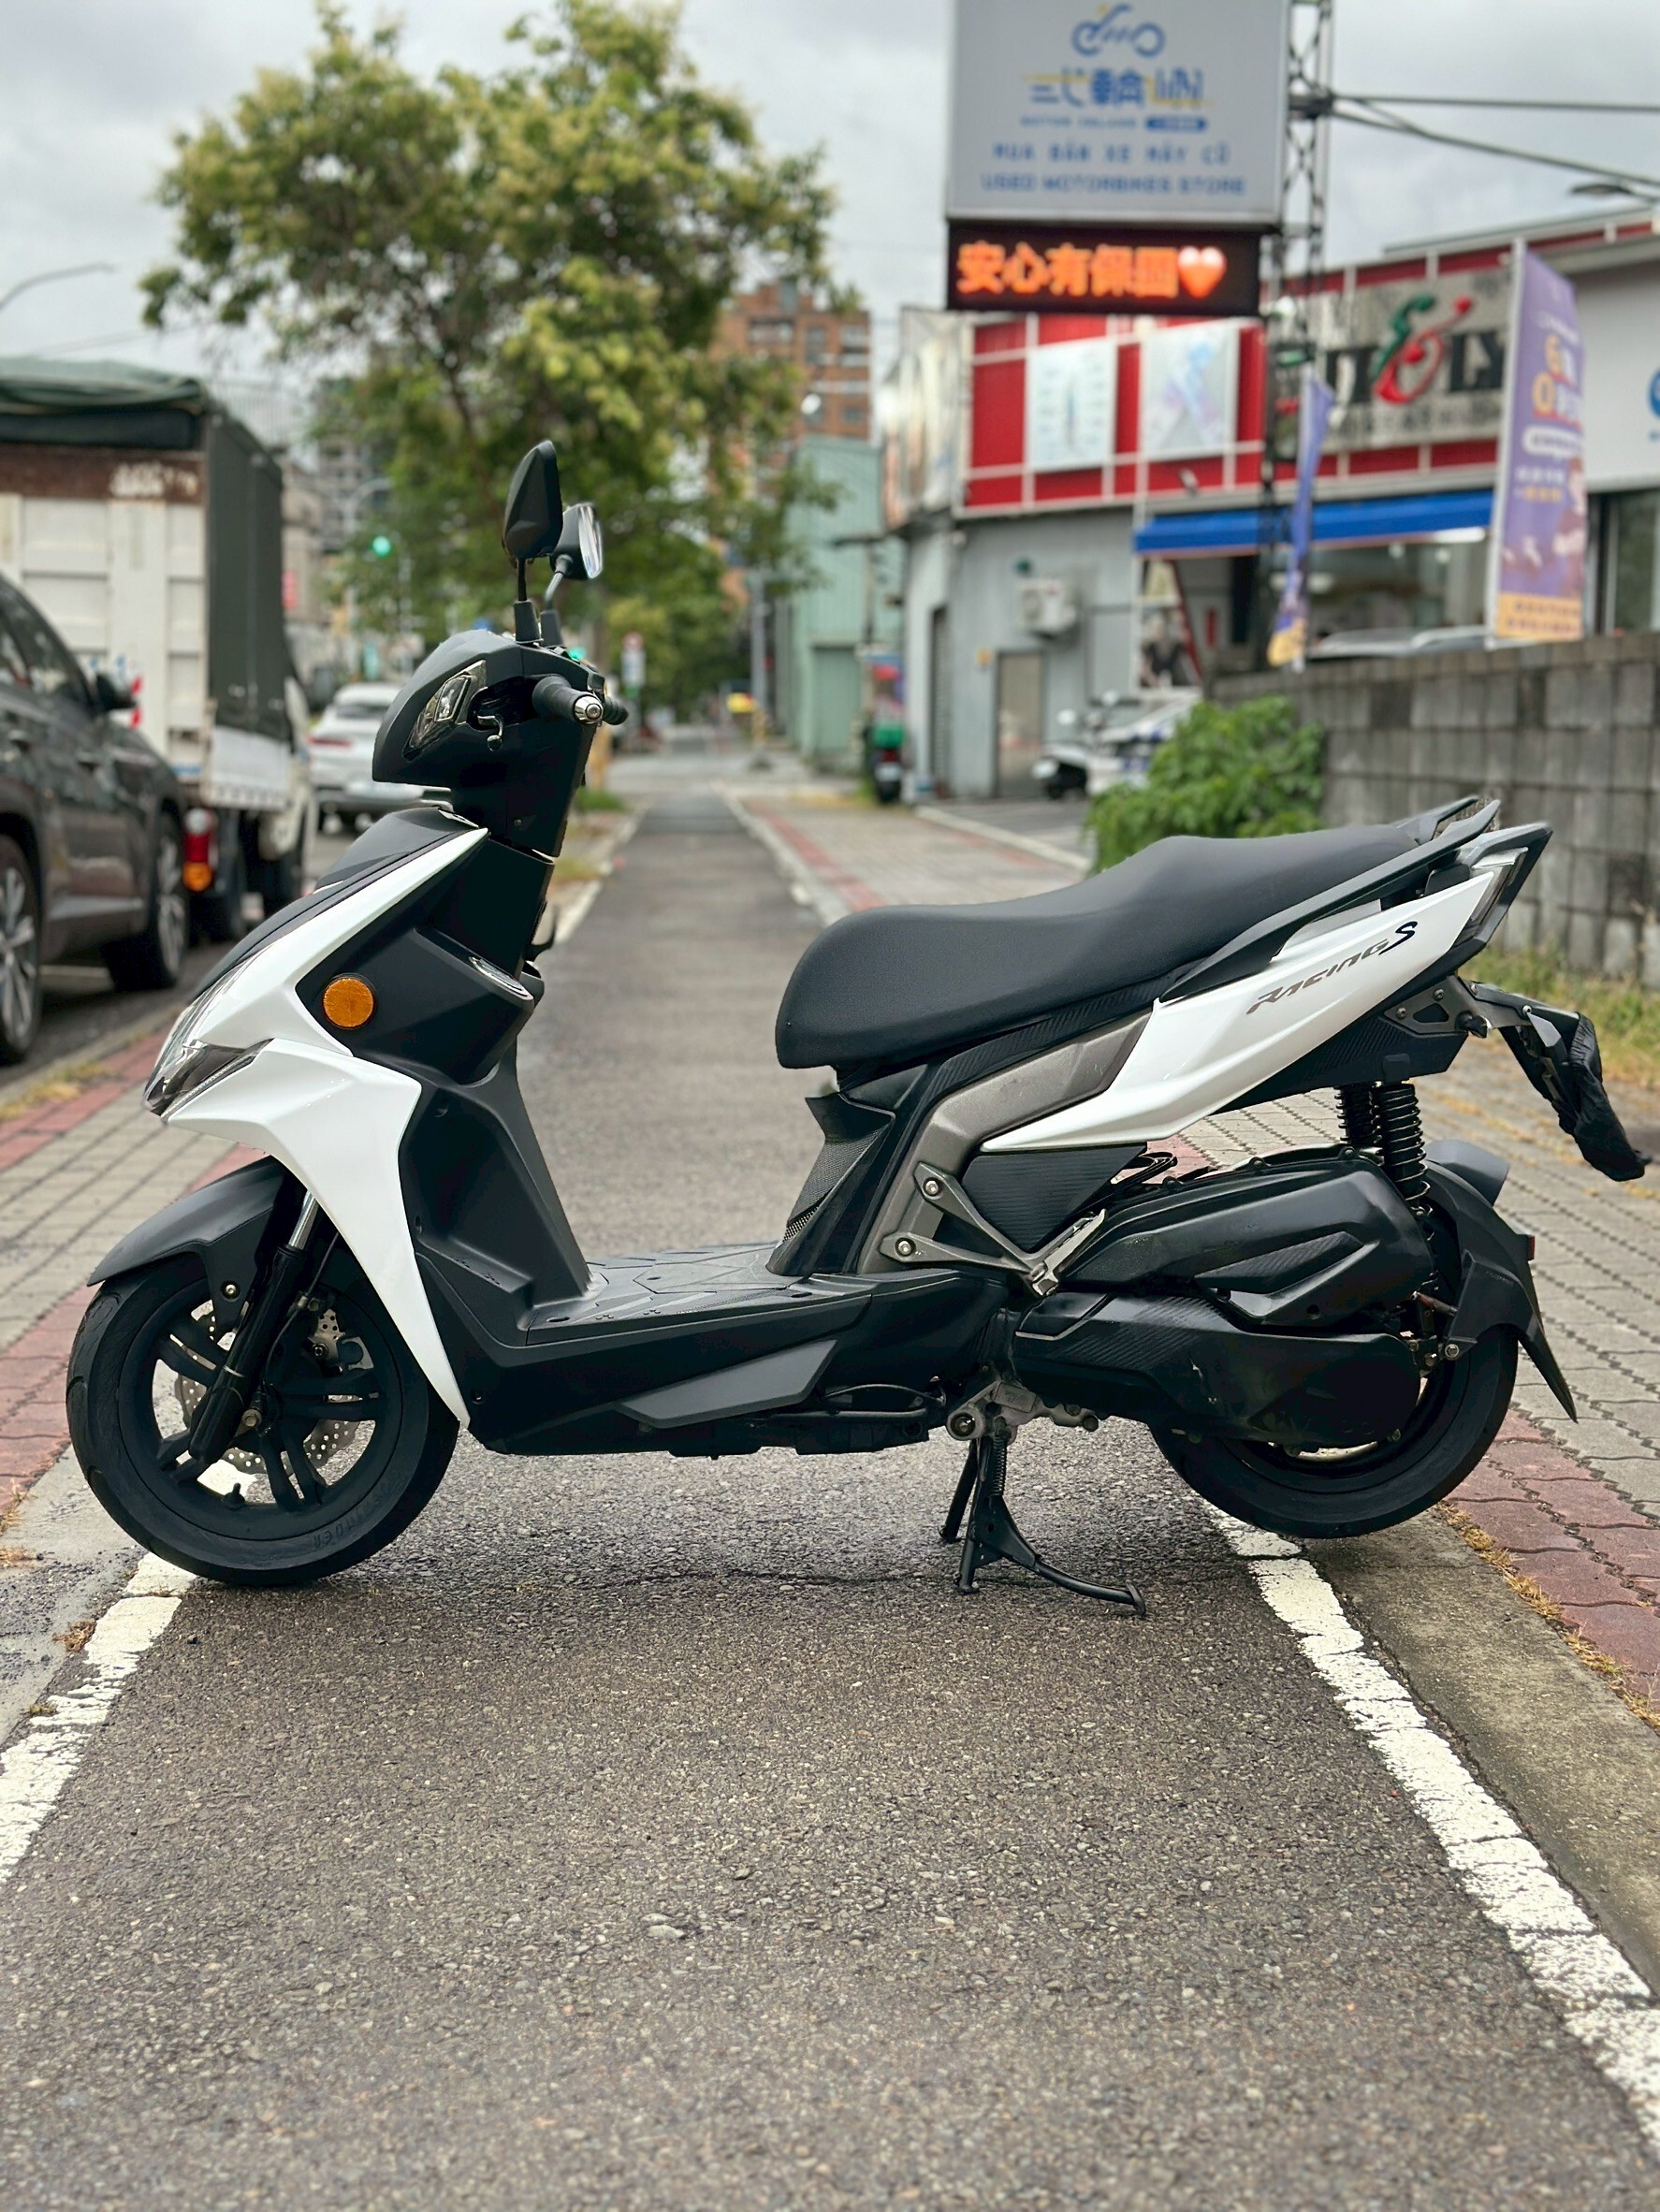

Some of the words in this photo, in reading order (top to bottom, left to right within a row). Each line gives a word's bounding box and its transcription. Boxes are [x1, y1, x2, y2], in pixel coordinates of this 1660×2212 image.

[983, 174, 1036, 191] USED
[1043, 175, 1172, 193] MOTORBIKES
[1179, 176, 1245, 194] STORE
